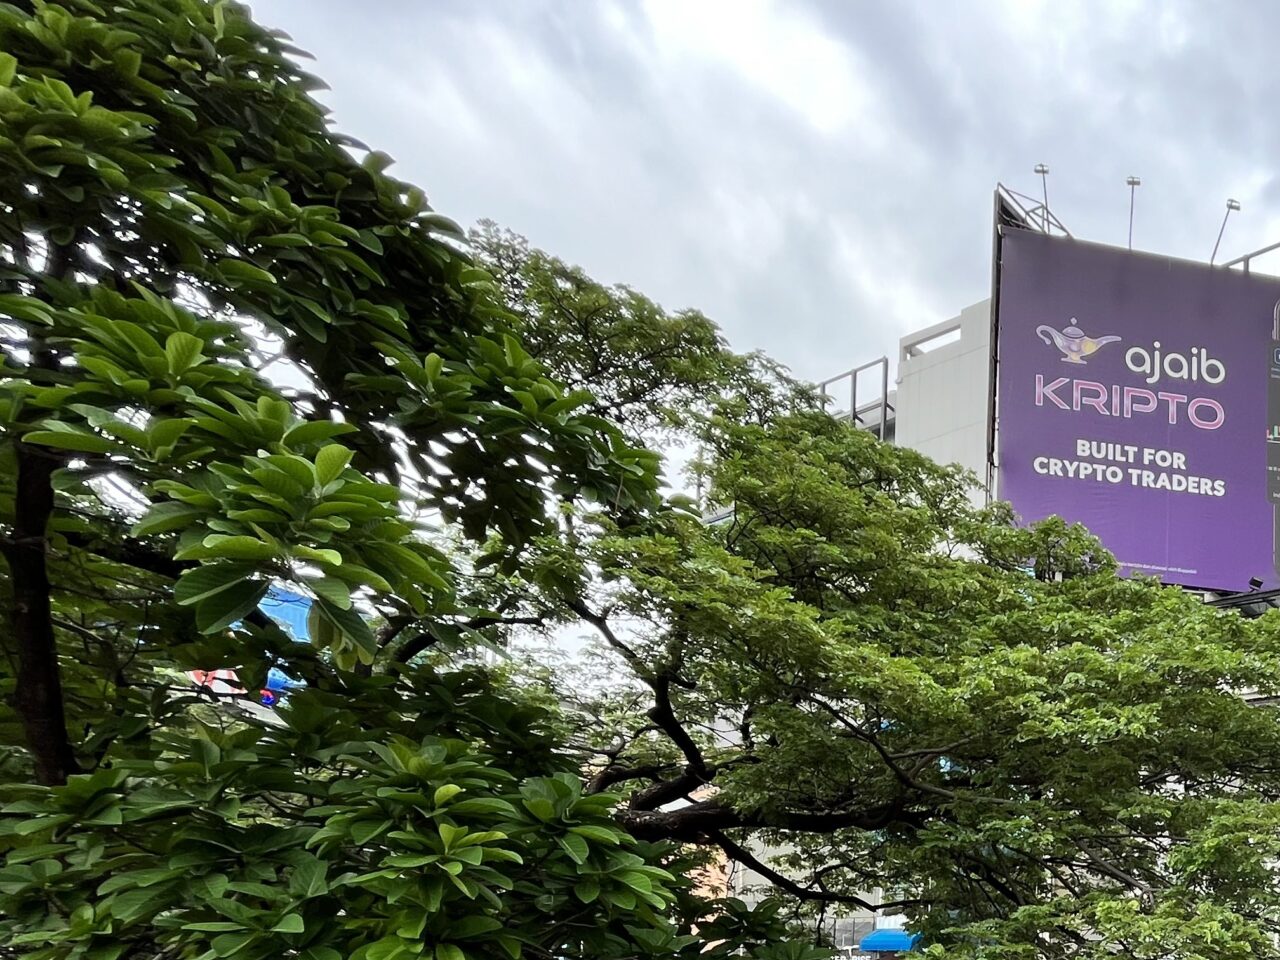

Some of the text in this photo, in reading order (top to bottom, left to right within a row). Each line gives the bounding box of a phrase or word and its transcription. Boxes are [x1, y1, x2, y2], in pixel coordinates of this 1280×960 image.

[1125, 341, 1226, 384] ajaib
[1035, 374, 1225, 430] KRIPTO
[1076, 439, 1186, 470] BUILT FOR
[1033, 457, 1226, 497] CRYPTO TRADERS
